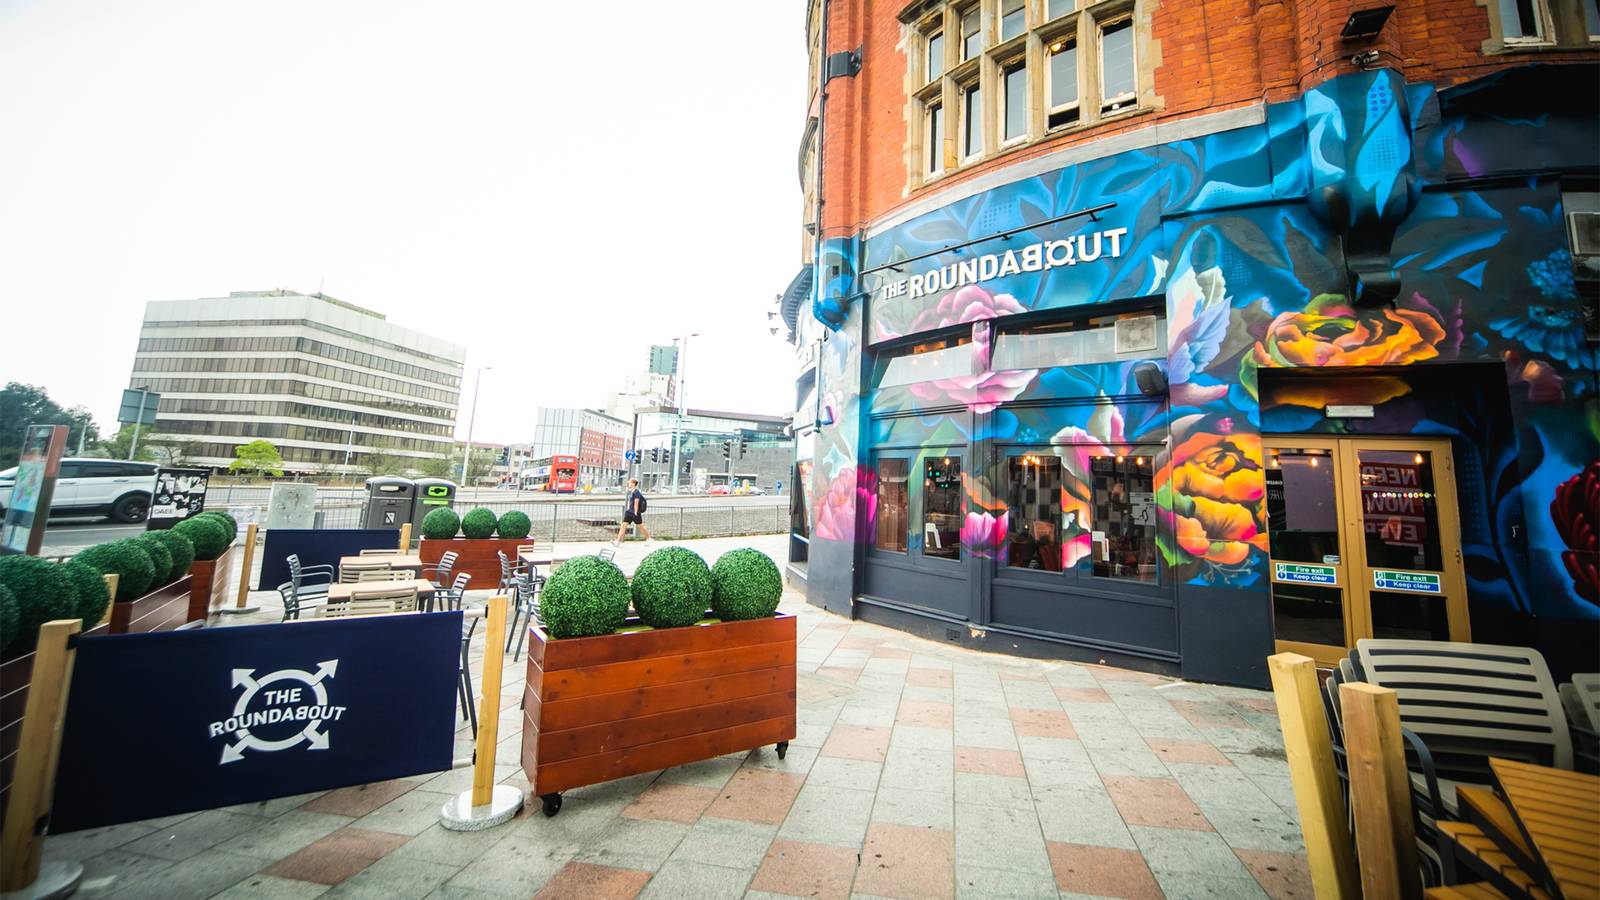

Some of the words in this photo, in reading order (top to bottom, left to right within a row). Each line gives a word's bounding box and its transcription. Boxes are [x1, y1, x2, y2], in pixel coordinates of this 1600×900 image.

[881, 280, 907, 300] THE
[909, 227, 1128, 299] ROUNDABOUT
[1295, 566, 1310, 574] Fire
[1293, 573, 1310, 581] Keep
[1395, 573, 1411, 581] Fire
[1393, 581, 1412, 589] Keep
[263, 687, 303, 706] THE
[208, 704, 347, 739] ROUNDABOUT
